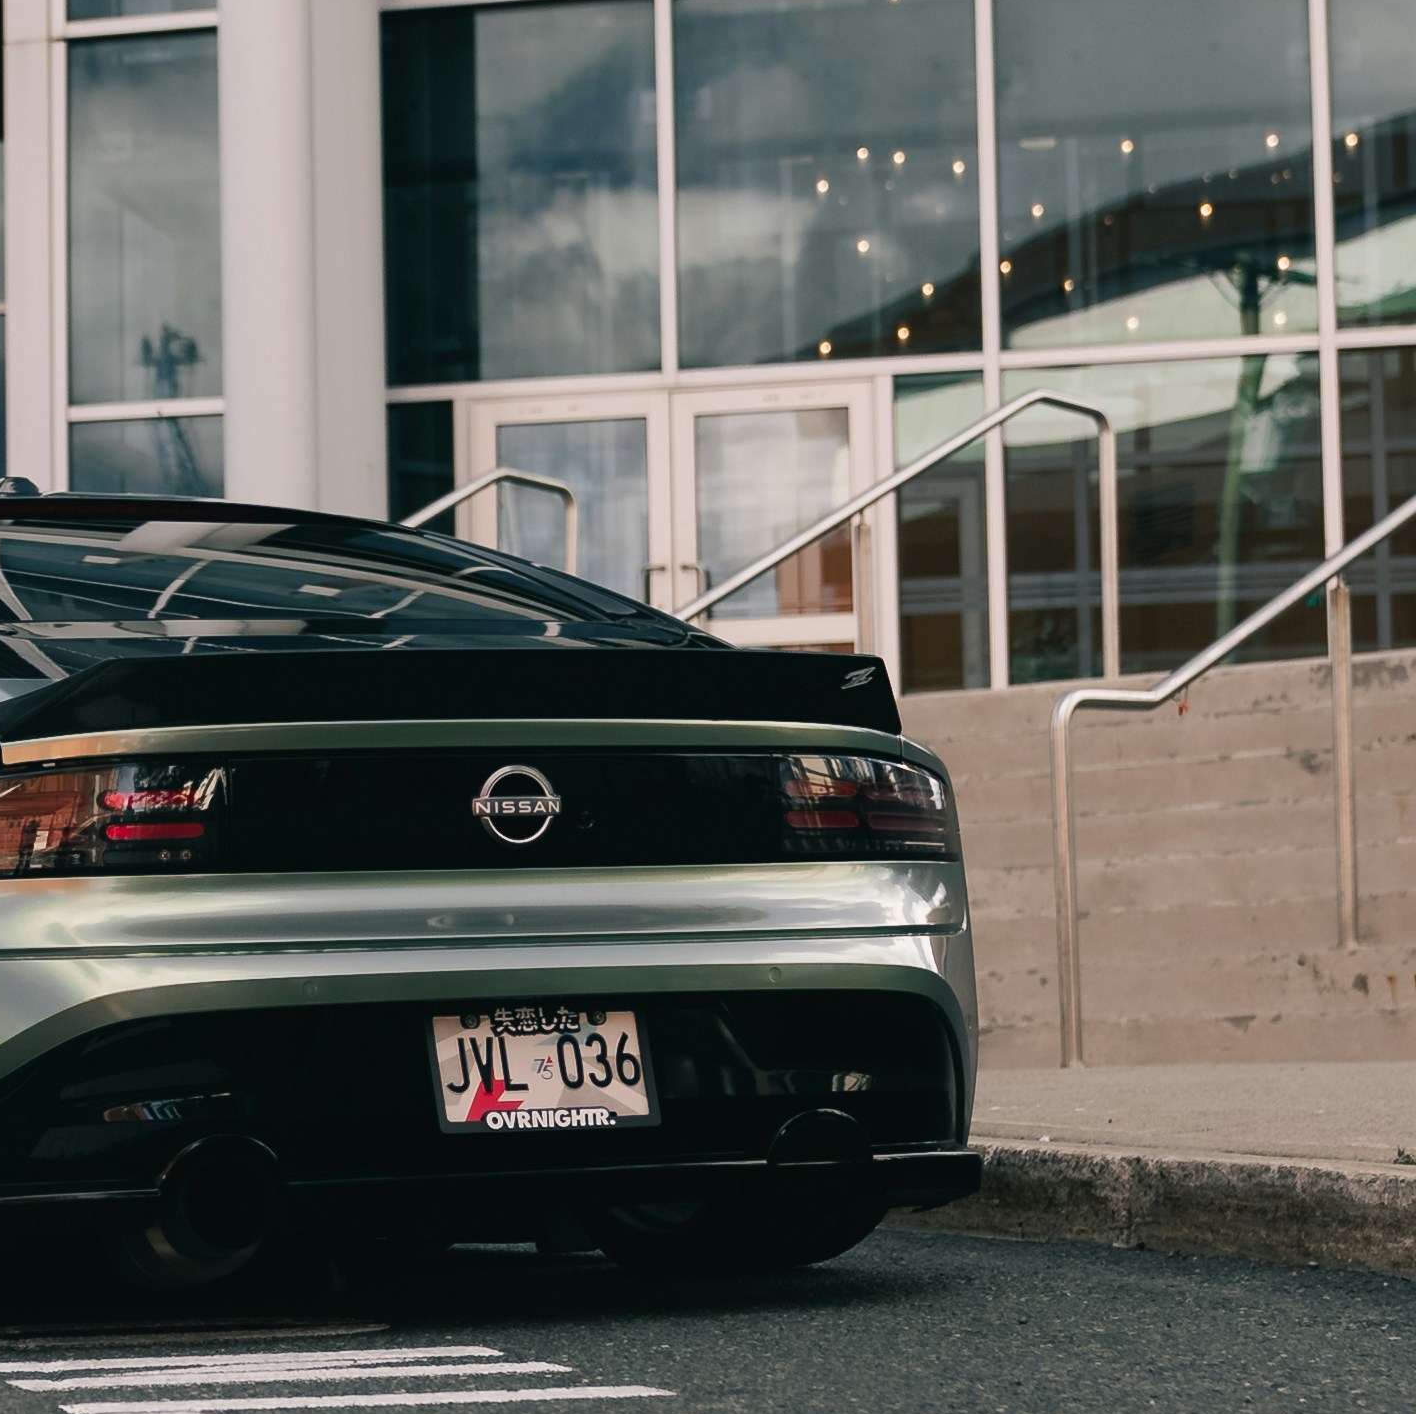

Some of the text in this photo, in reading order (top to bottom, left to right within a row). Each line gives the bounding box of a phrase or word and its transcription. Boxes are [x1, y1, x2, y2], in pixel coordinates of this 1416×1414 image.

[475, 800, 560, 814] NISSAN
[494, 1006, 579, 1032] 失恋した
[446, 1032, 642, 1093] JVL 036
[486, 1108, 616, 1130] OVRNIGHTR.
